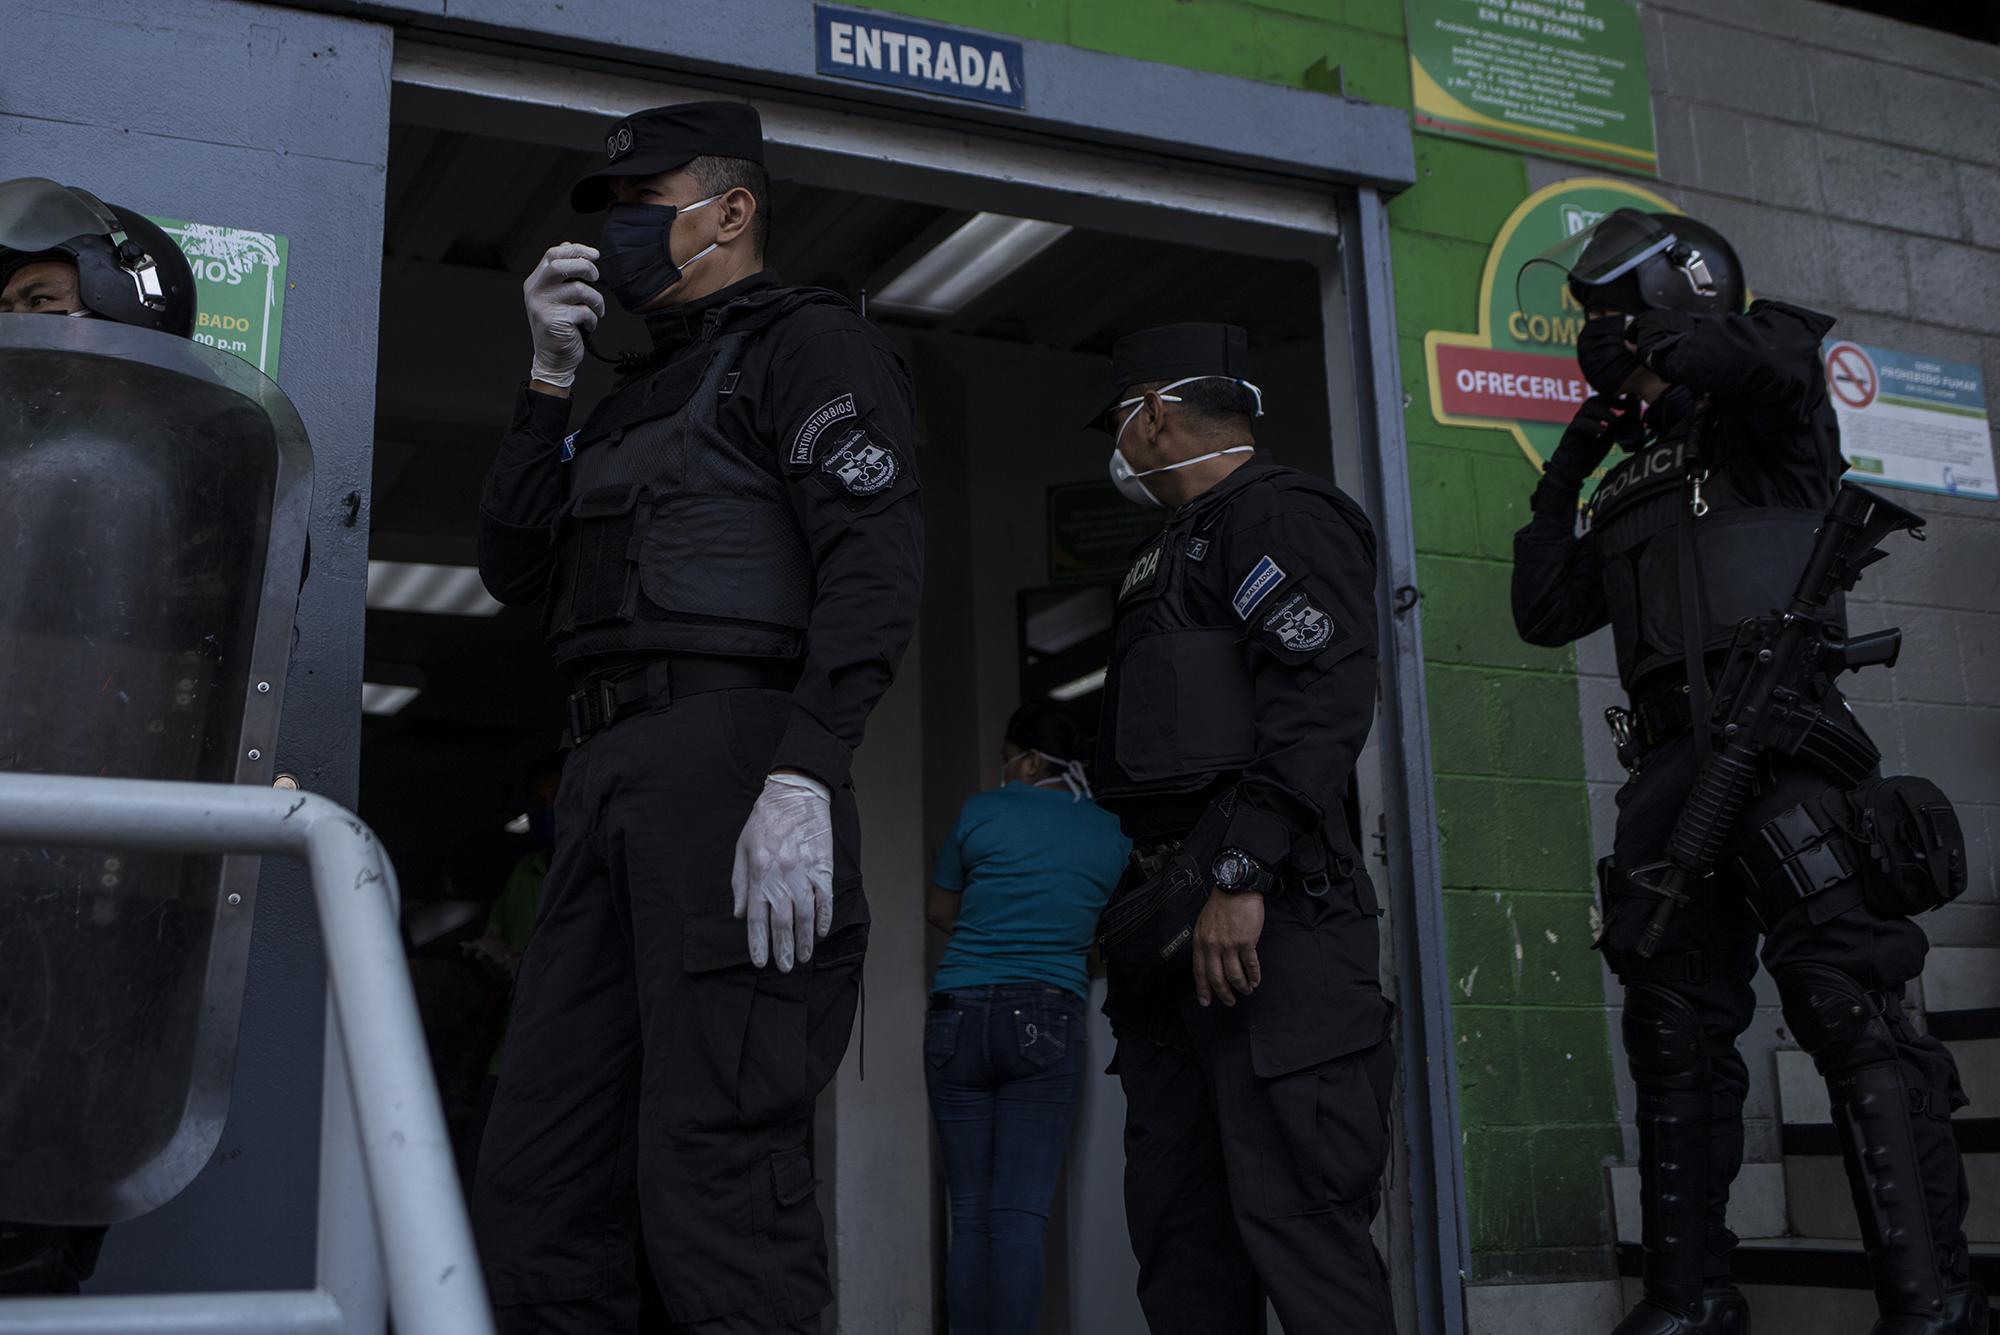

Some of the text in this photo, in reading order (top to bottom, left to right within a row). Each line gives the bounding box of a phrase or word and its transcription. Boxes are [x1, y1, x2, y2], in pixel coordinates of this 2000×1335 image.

[1502, 12, 1539, 33] ESTA
[830, 21, 1012, 93] ENTRADA
[196, 312, 250, 331] BADO
[1508, 310, 1586, 347] COM
[192, 333, 214, 346] 00
[1456, 368, 1583, 402] OFRECERLE
[1881, 366, 1977, 392] PROHIBIDO FUMAR
[796, 400, 852, 460] ANTIDISTURBIOS
[1597, 443, 1684, 507] POLICI
[1245, 567, 1275, 599] SALVADOR
